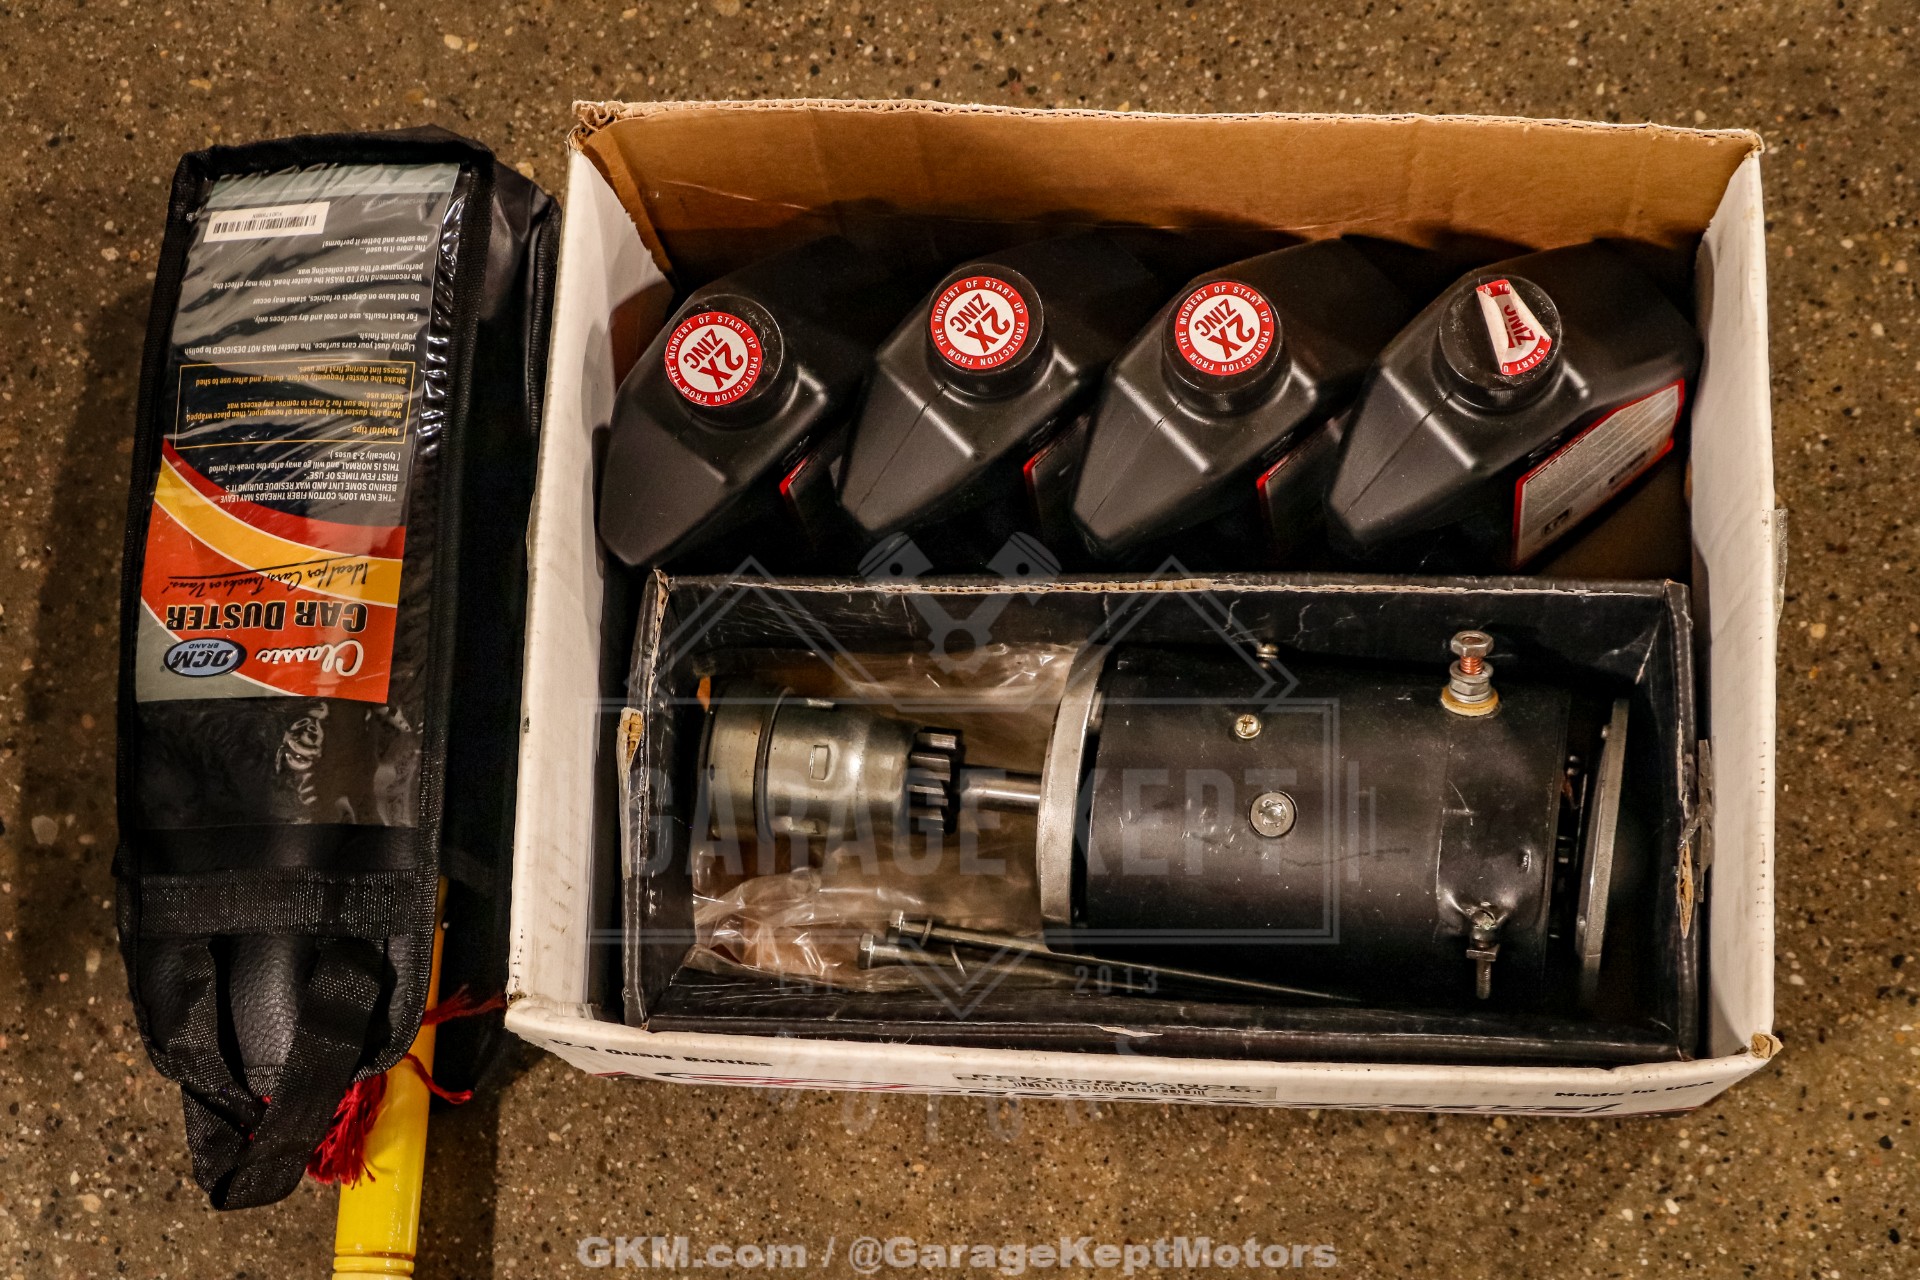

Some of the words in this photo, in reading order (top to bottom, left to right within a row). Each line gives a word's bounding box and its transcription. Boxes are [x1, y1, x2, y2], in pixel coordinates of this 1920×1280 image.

[322, 237, 355, 248] performs!
[361, 237, 382, 246] better
[382, 236, 395, 245] and
[396, 235, 416, 244] softer
[415, 244, 426, 252] The
[312, 266, 344, 275] collecting
[344, 265, 359, 274] dust
[360, 265, 371, 273] the
[380, 262, 423, 272] performance
[325, 275, 345, 284] WASH
[356, 274, 370, 283] NOT
[371, 273, 411, 282] recommend
[411, 273, 422, 281] We
[259, 279, 271, 287] this
[966, 280, 978, 289] OF
[985, 281, 1014, 299] START
[1214, 285, 1227, 293] OF
[272, 296, 286, 304] may
[286, 296, 307, 304] stains
[308, 294, 332, 303] fabrics,
[342, 292, 367, 301] carpets
[378, 293, 396, 301] leave
[398, 293, 409, 301] not
[1233, 286, 1262, 306] START
[253, 297, 271, 305] occur
[935, 287, 960, 322] MOMENT
[1014, 302, 1024, 314] UP
[1180, 290, 1207, 325] MOMENT
[323, 313, 338, 321] cool
[390, 313, 405, 322] best
[407, 313, 418, 322] For
[950, 293, 990, 333] ZINC
[1194, 298, 1237, 336] ZINC
[1260, 311, 1270, 323] UP
[269, 315, 298, 323] surfaces
[310, 314, 323, 322] and
[699, 315, 711, 324] OF
[717, 315, 747, 334] START
[964, 307, 1010, 353] 2X
[358, 332, 380, 341] finish.
[380, 332, 400, 340] paint
[401, 332, 417, 340] your
[668, 322, 693, 359] MOMENT
[935, 328, 946, 346] THE
[1179, 331, 1190, 349] THE
[1207, 313, 1255, 360] 2X
[300, 343, 311, 351] the
[358, 341, 374, 349] your
[374, 342, 390, 351] dust
[391, 341, 415, 352] Lightly
[746, 336, 757, 349] UP
[980, 322, 1025, 365] PROTECTION
[184, 345, 204, 356] polish
[212, 345, 246, 355] DESIGNED
[247, 345, 260, 353] NOT
[262, 344, 277, 353] WAS
[278, 343, 299, 352] duster
[683, 328, 723, 369] ZINC
[1222, 331, 1270, 372] PROTECTION
[947, 349, 973, 365] FROM
[1189, 352, 1214, 371] FROM
[1517, 348, 1544, 370] START
[345, 365, 368, 374] during
[698, 342, 744, 390] 2X
[383, 367, 407, 375] excess
[668, 365, 681, 383] THE
[232, 377, 248, 385] after
[262, 374, 283, 384] during
[310, 373, 345, 382] frequently
[346, 374, 368, 383] duster
[369, 375, 382, 384] the
[383, 376, 406, 384] Shake
[714, 357, 759, 402] PROTECTION
[196, 379, 211, 387] shed
[380, 392, 404, 401] before
[683, 386, 708, 403] FROM
[308, 399, 324, 408] days
[332, 400, 342, 408] for
[358, 401, 369, 409] the
[380, 401, 403, 409] duster
[186, 412, 212, 422] wrapped
[214, 411, 230, 420] place
[231, 410, 246, 419] then
[248, 408, 284, 418] newspaper,
[294, 409, 315, 417] sheets
[342, 409, 367, 417] duster
[383, 409, 402, 419] Wrap
[352, 425, 368, 435] tips
[369, 426, 399, 436] Helpful
[366, 450, 396, 460] typically
[209, 463, 229, 474] period
[256, 462, 267, 471] the
[268, 462, 284, 470] after
[285, 460, 302, 468] away
[326, 461, 339, 469] and
[341, 461, 372, 471] NORMAL
[382, 462, 399, 471] THIS
[336, 471, 359, 480] TIMES
[360, 472, 376, 481] FEW
[377, 472, 398, 481] FIRST
[239, 483, 263, 492] DURING
[265, 482, 294, 491] RESIDUE
[295, 481, 311, 490] WAX
[312, 481, 328, 490] AND
[328, 482, 344, 490] LINT
[345, 482, 367, 491] SOME
[368, 482, 397, 491] BEHIND
[220, 494, 239, 503] LEAVE
[240, 492, 254, 502] MAY
[255, 491, 285, 501] THREADS
[287, 491, 307, 500] FIBER
[308, 491, 336, 501] COTTON
[338, 492, 358, 501] 100%
[360, 492, 376, 502] NEW
[330, 562, 368, 586] Ideal
[220, 575, 265, 596] Trucks
[267, 571, 302, 591] Cars,
[162, 581, 206, 597] Vans!
[165, 600, 286, 632] DUSTER
[293, 600, 368, 634] CAR
[188, 642, 219, 650] BRAND
[171, 649, 232, 670] DCM
[256, 639, 364, 676] Classic
[605, 1048, 676, 1060] Quart
[682, 1056, 773, 1066] Bottles
